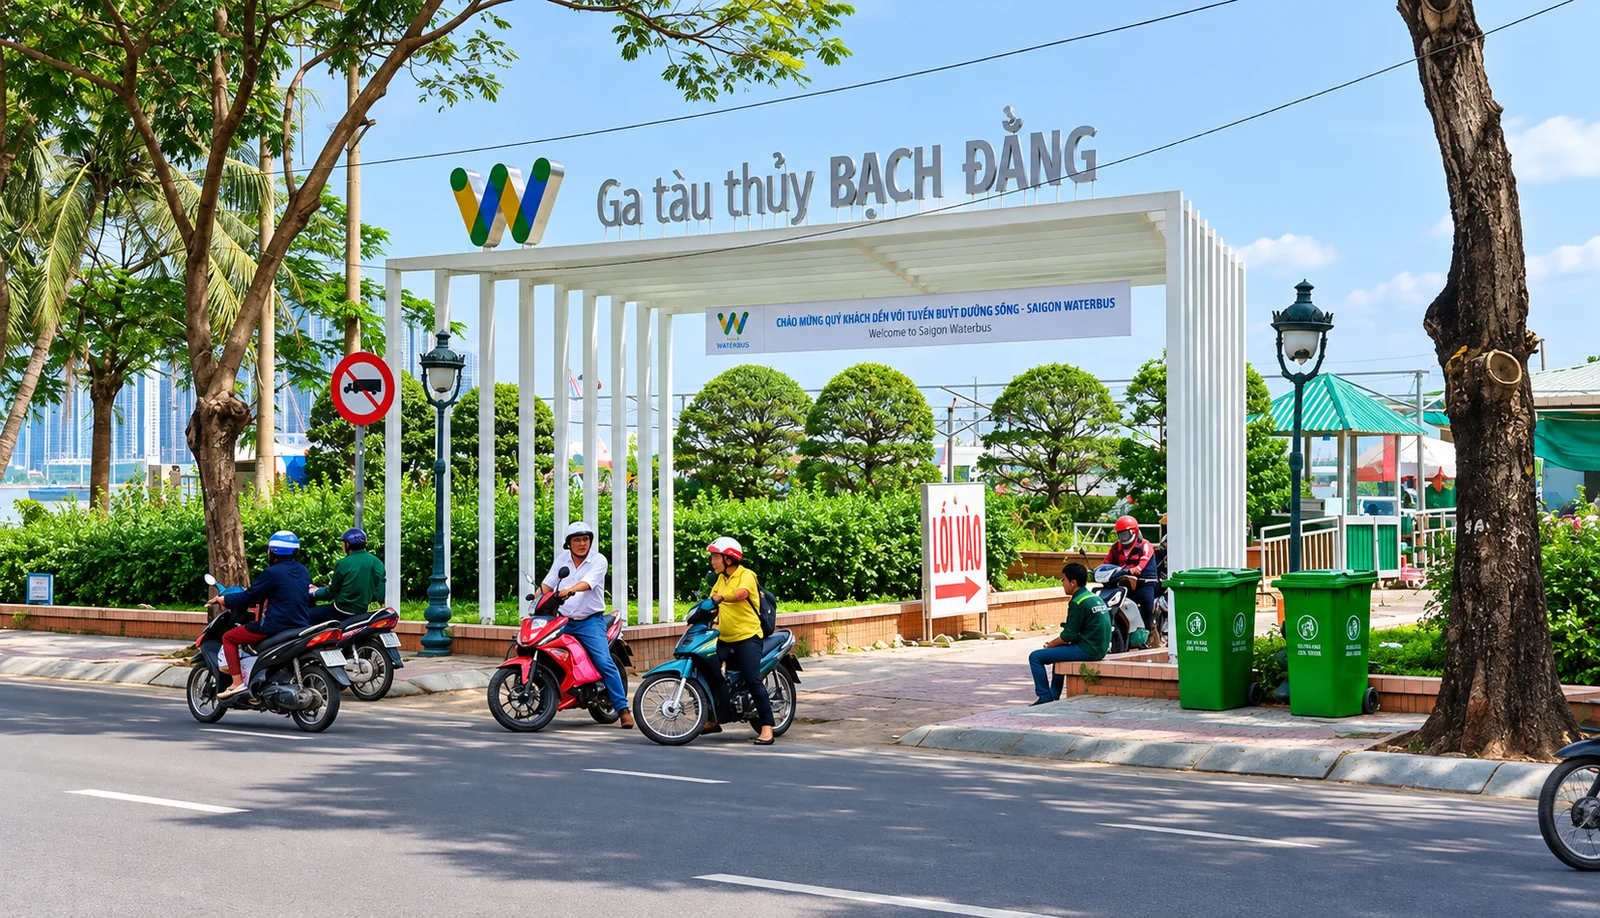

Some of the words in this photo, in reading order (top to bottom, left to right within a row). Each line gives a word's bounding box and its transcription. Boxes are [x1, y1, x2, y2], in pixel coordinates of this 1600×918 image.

[597, 178, 643, 227] Ga
[652, 169, 713, 224] tàu
[724, 152, 815, 225] thủy
[830, 144, 944, 219] BẠCH
[843, 311, 870, 324] KHÁCH
[995, 302, 1019, 315] SÔNG
[1027, 301, 1061, 314] SAIGON
[1064, 297, 1115, 311] WATERBUS
[869, 328, 906, 338] Welcome
[908, 328, 917, 337] to
[919, 325, 947, 338] Saigon
[950, 322, 992, 334] Waterbus
[933, 500, 953, 574] LỐI
[956, 505, 982, 572] VÀO
